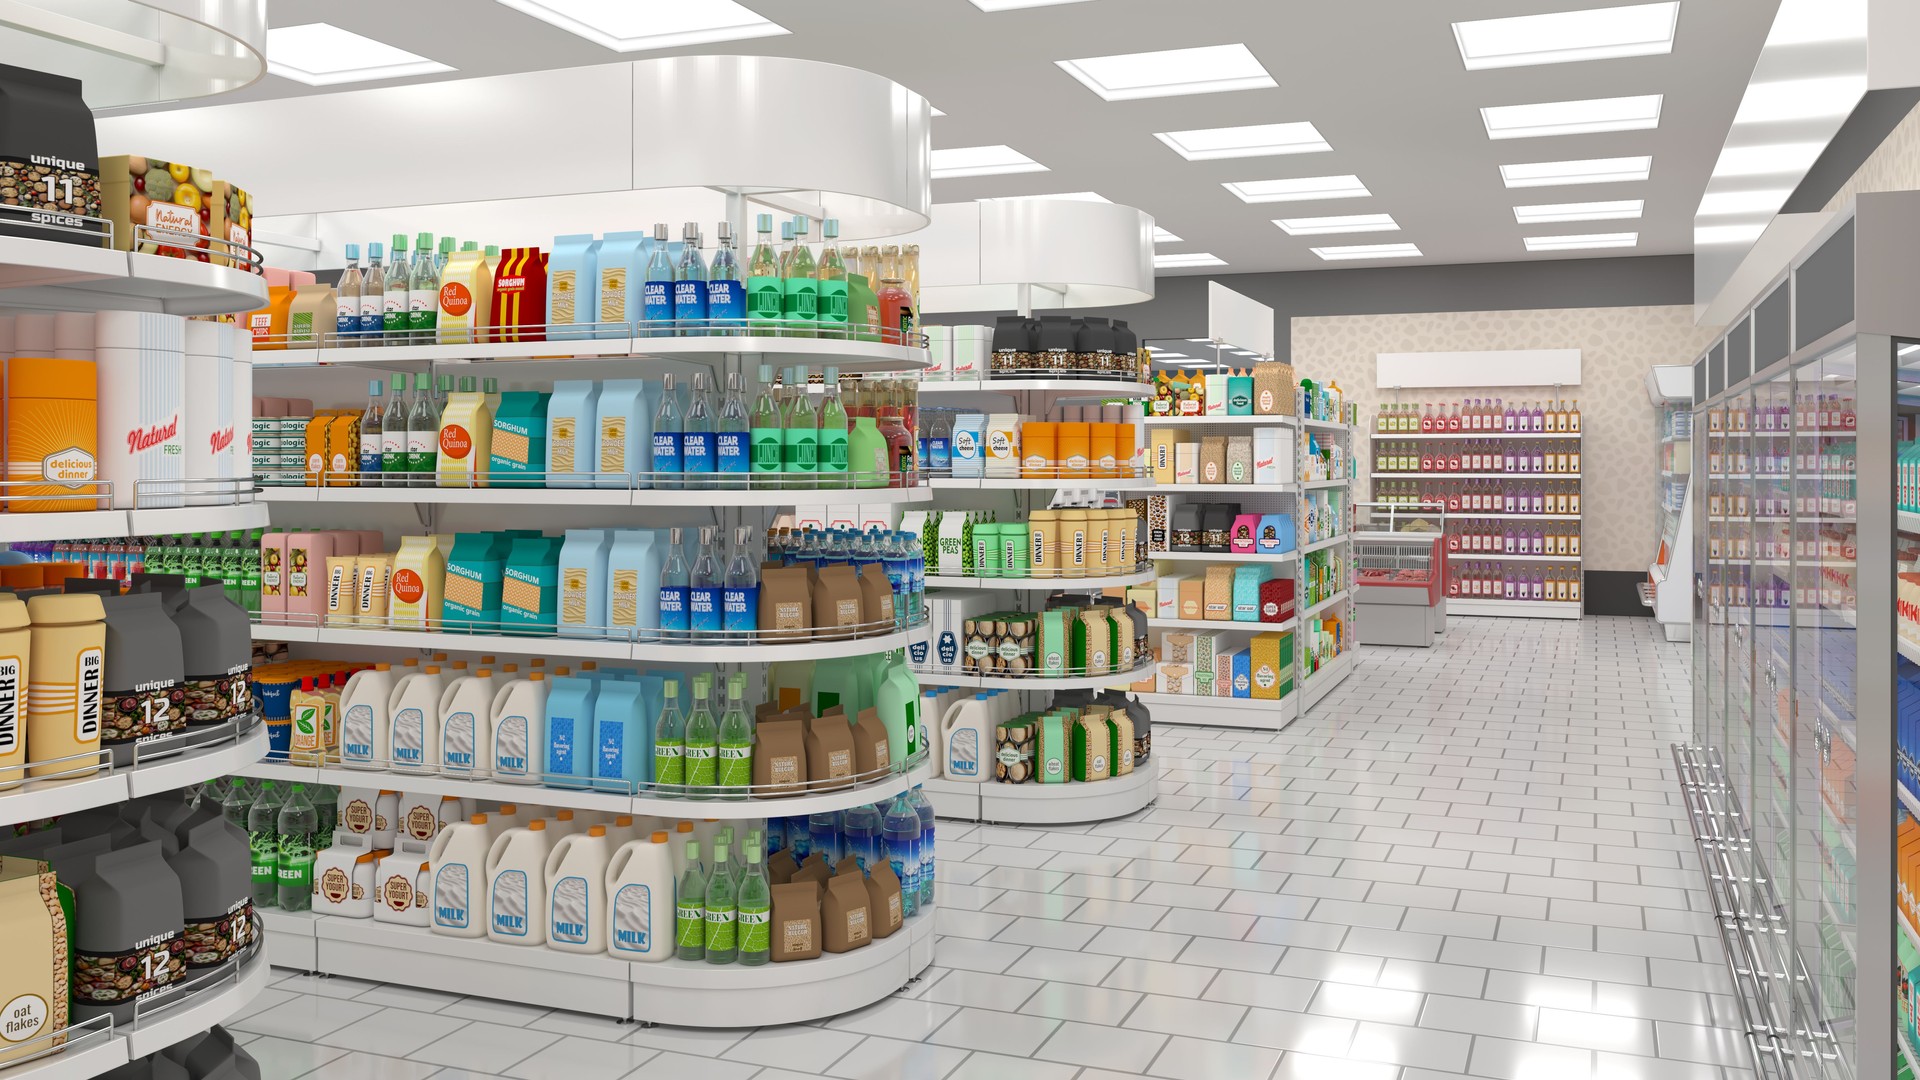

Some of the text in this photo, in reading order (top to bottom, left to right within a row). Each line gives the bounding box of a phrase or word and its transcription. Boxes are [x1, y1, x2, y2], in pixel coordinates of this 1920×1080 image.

[30, 154, 85, 172] unique
[42, 177, 73, 204] 11
[32, 212, 84, 227] spices
[156, 209, 192, 227] Natural
[498, 278, 525, 288] SORGHUM
[444, 286, 457, 296] Red
[645, 285, 665, 295] CLEAR
[675, 284, 695, 294] CLEAR
[709, 284, 729, 294] CLEAR
[443, 296, 468, 307] Quinoa
[1002, 355, 1013, 365] 11
[1053, 355, 1063, 365] 11
[1100, 357, 1109, 366] 11
[494, 419, 528, 435] SORGHUM
[127, 414, 178, 455] Natural
[444, 428, 457, 438] Red
[443, 439, 468, 449] Quinoa
[654, 436, 674, 446] CLEAR
[684, 436, 704, 446] CLEAR
[718, 436, 738, 446] CLEAR
[959, 437, 971, 446] Soft
[993, 437, 1005, 446] Soft
[164, 445, 182, 455] FRESH
[50, 459, 92, 469] delicious
[492, 456, 526, 471] organic grain
[58, 470, 89, 479] dinner
[940, 538, 962, 547] GREEN
[943, 546, 959, 554] PEAS
[448, 563, 482, 581] SORGHUM
[505, 568, 539, 585] SORGHUM
[396, 573, 409, 582] Red
[331, 575, 341, 607] DINNER
[362, 576, 372, 609] DINNER
[396, 583, 420, 593] Quinoa
[660, 591, 680, 601] CLEAR
[691, 592, 711, 602] CLEAR
[725, 592, 745, 602] CLEAR
[445, 602, 481, 618] organic grain
[503, 604, 538, 620] organic grain
[85, 656, 100, 667] BIG
[228, 663, 249, 676] unique
[135, 679, 175, 693] unique
[231, 681, 247, 704] 12
[83, 669, 99, 734] DINNER
[141, 698, 170, 724] 12
[347, 744, 369, 755] MILK
[397, 748, 419, 760] MILK
[448, 752, 471, 765] MILK
[500, 756, 524, 769] MILK
[953, 761, 975, 770] MILK
[351, 806, 366, 814] SUPER
[349, 815, 368, 823] YOGURT
[413, 812, 429, 821] SUPER
[411, 821, 431, 830] YOGURT
[327, 874, 344, 882] SUPER
[326, 883, 346, 892] YOGURT
[390, 882, 407, 891] SUPER
[389, 890, 409, 900] YOGURT
[228, 896, 249, 915] unique
[439, 907, 465, 921] MILK
[497, 914, 522, 928] MILK
[231, 915, 247, 942] 12
[556, 922, 584, 937] MILK
[135, 930, 175, 950] unique
[618, 930, 646, 945] MILK
[141, 950, 170, 979] 12
[14, 1004, 31, 1019] oat
[6, 1015, 39, 1034] flakes
